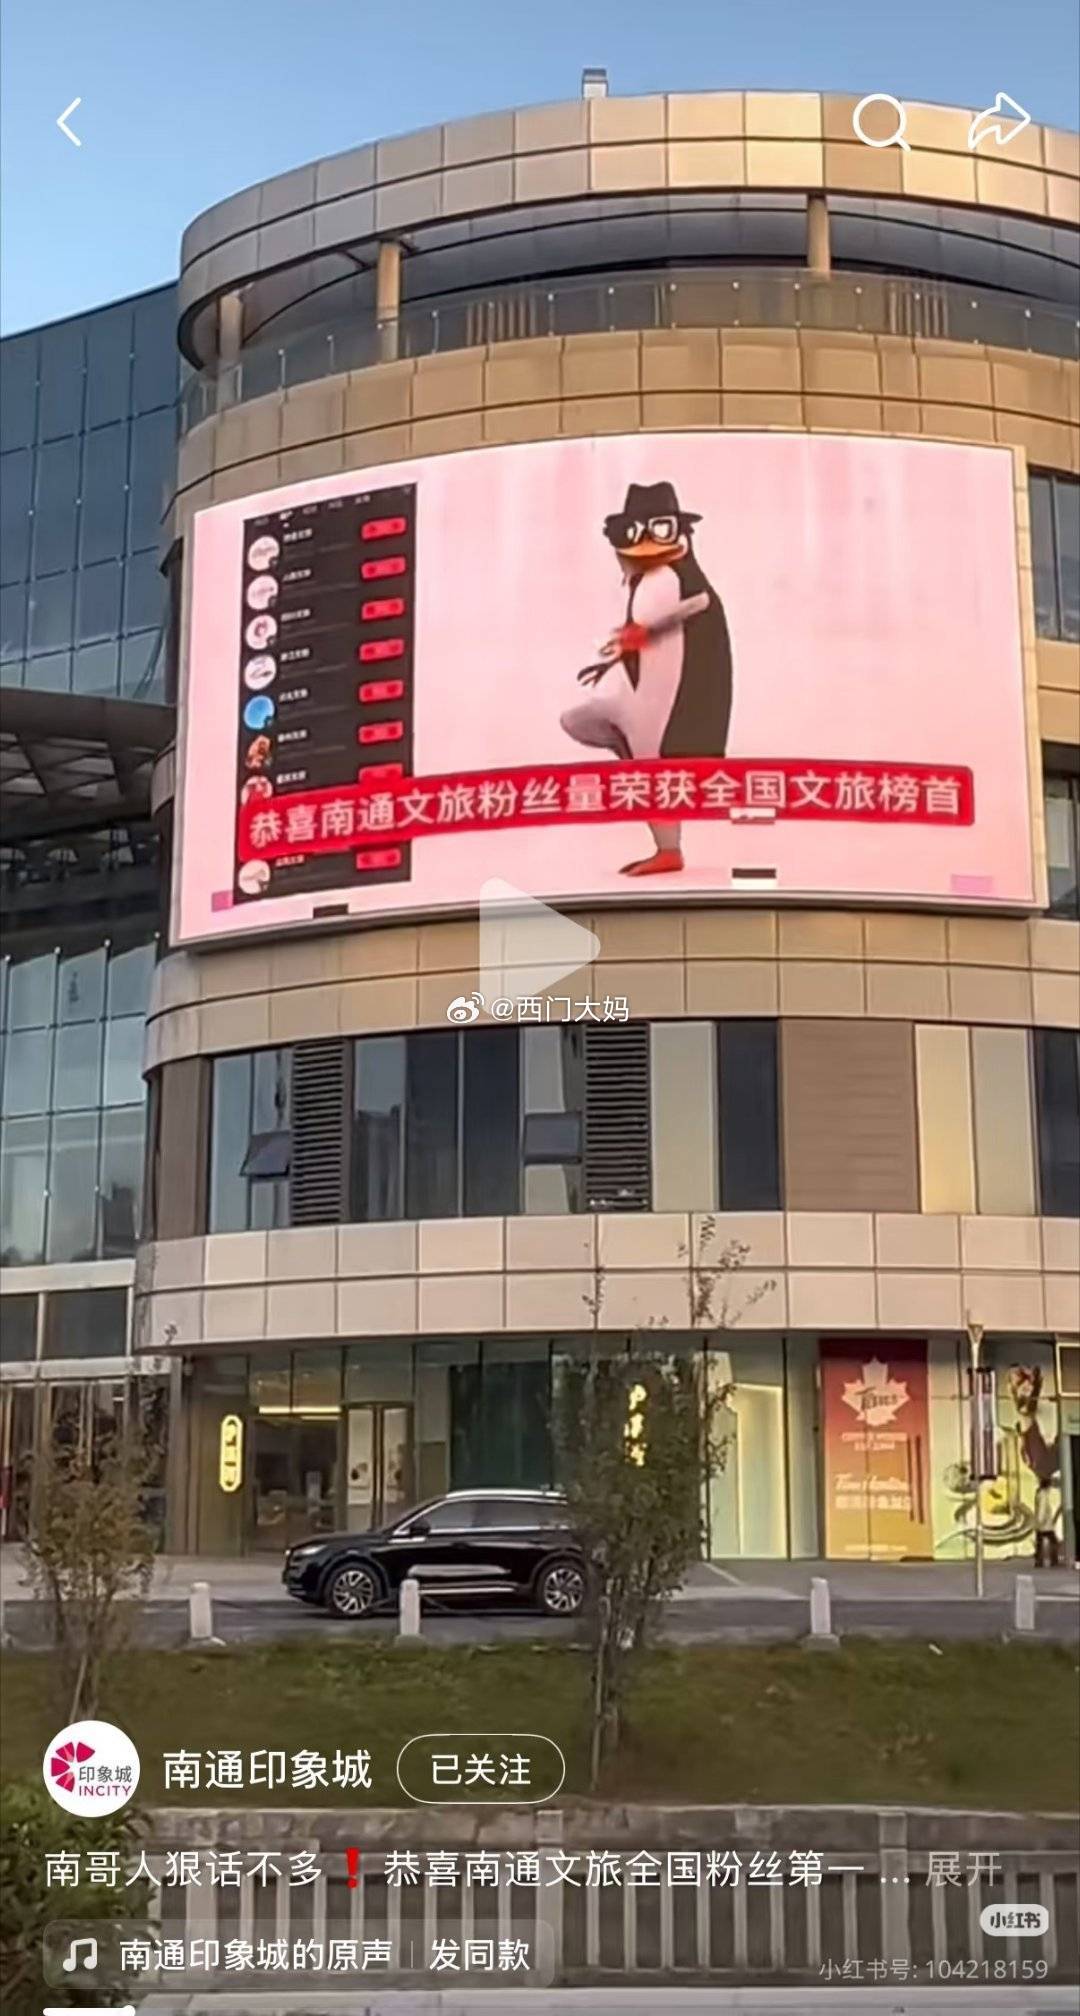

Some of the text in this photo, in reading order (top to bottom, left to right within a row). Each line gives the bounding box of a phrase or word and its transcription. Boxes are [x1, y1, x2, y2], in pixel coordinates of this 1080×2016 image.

[250, 769, 962, 848] 恭喜南通文旅粉丝量荣获全国文旅榜首
